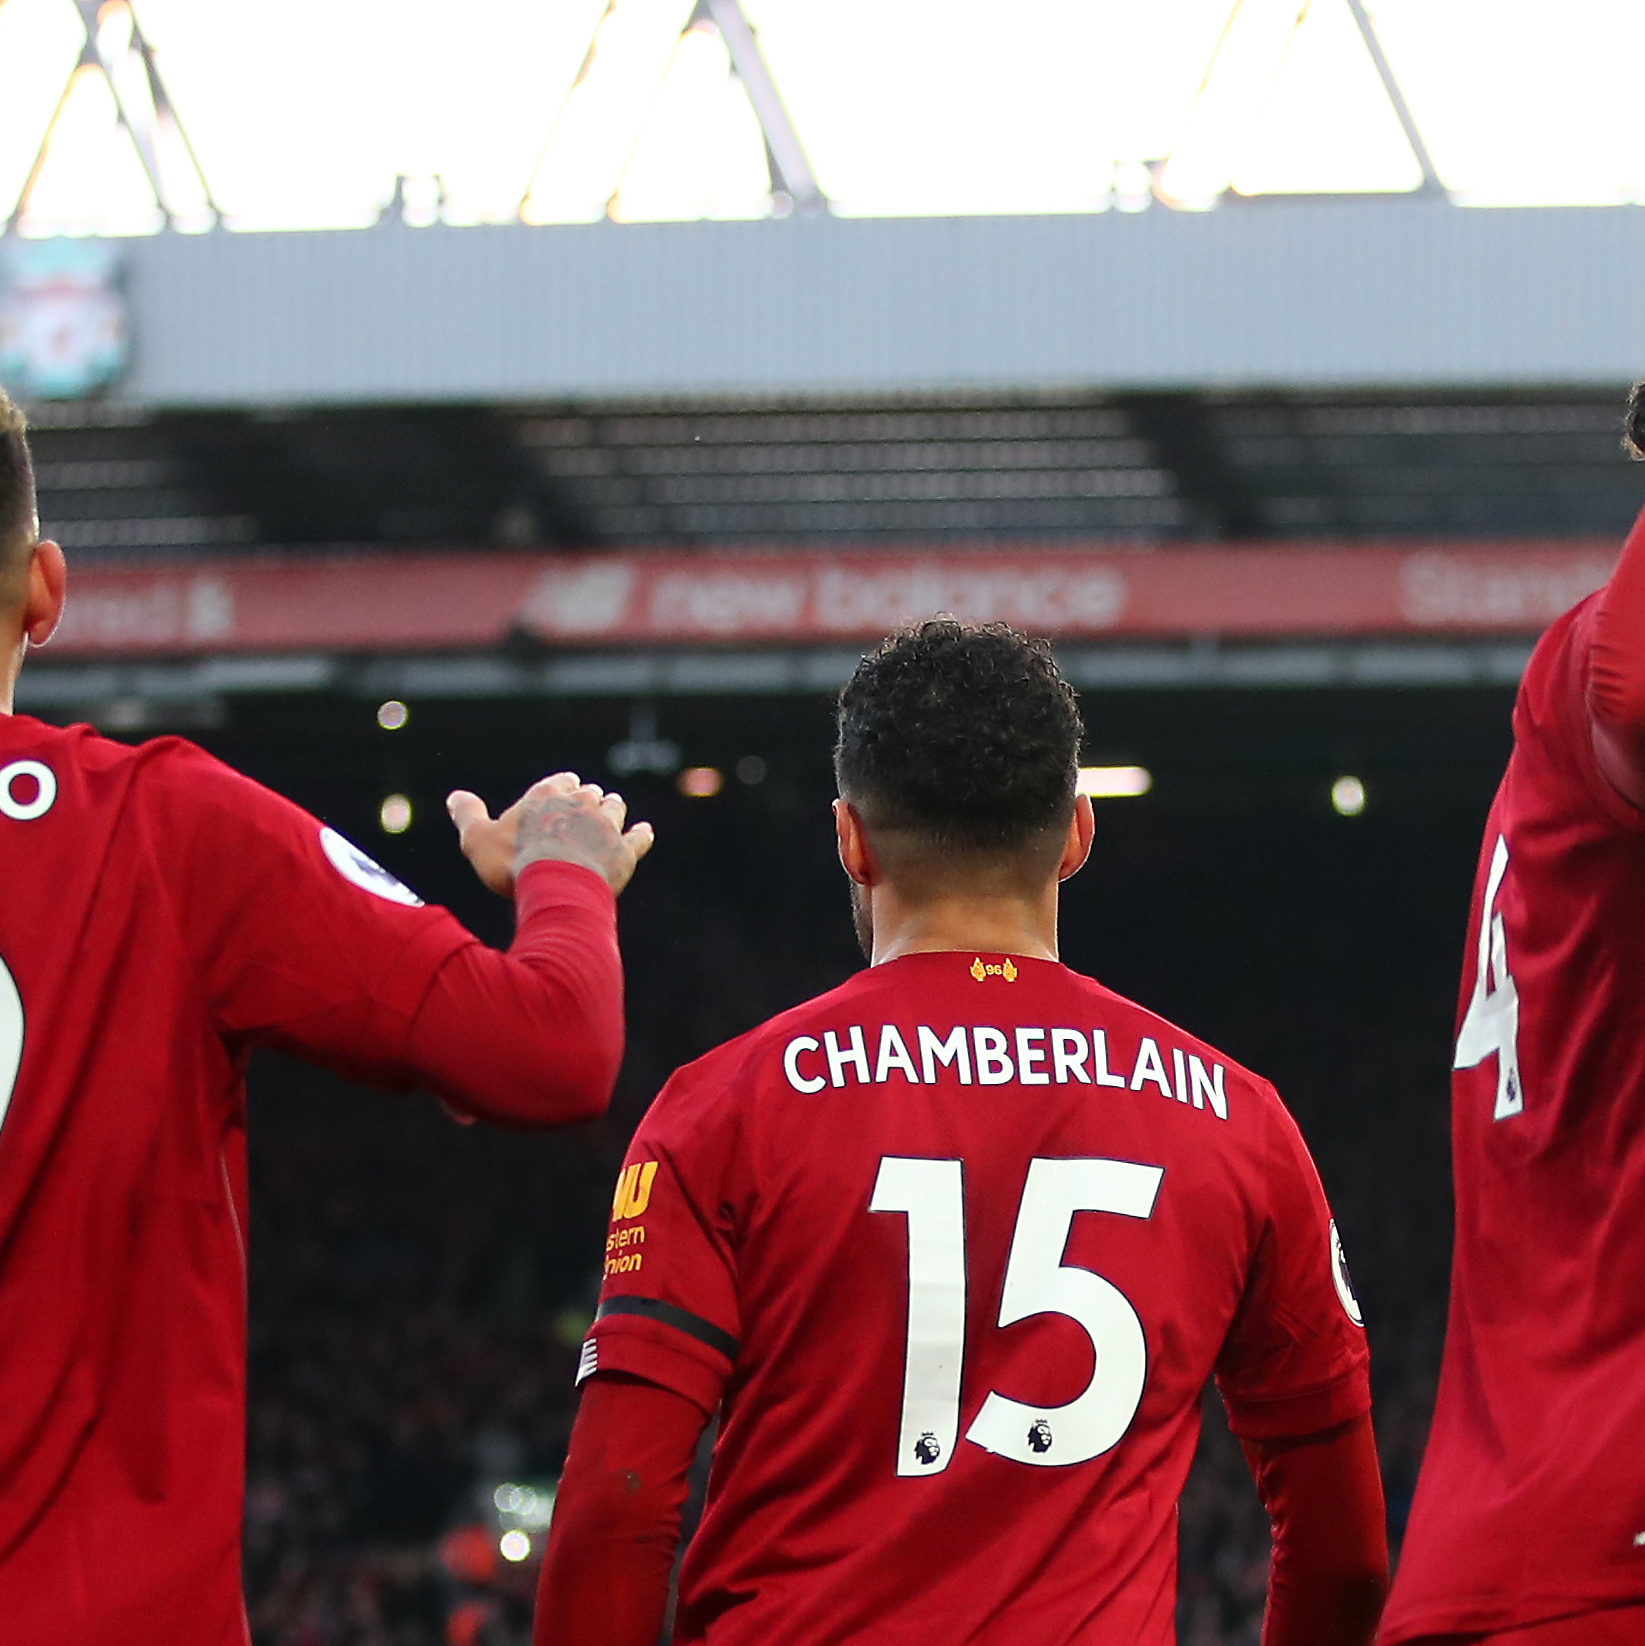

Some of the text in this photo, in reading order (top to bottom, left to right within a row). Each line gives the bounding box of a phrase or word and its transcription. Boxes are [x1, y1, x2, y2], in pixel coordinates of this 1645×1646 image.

[985, 964, 1003, 976] 96
[1453, 834, 1523, 1121] 4
[782, 1024, 1230, 1121] CHAMBERLAIN
[866, 1156, 1165, 1478] 15
